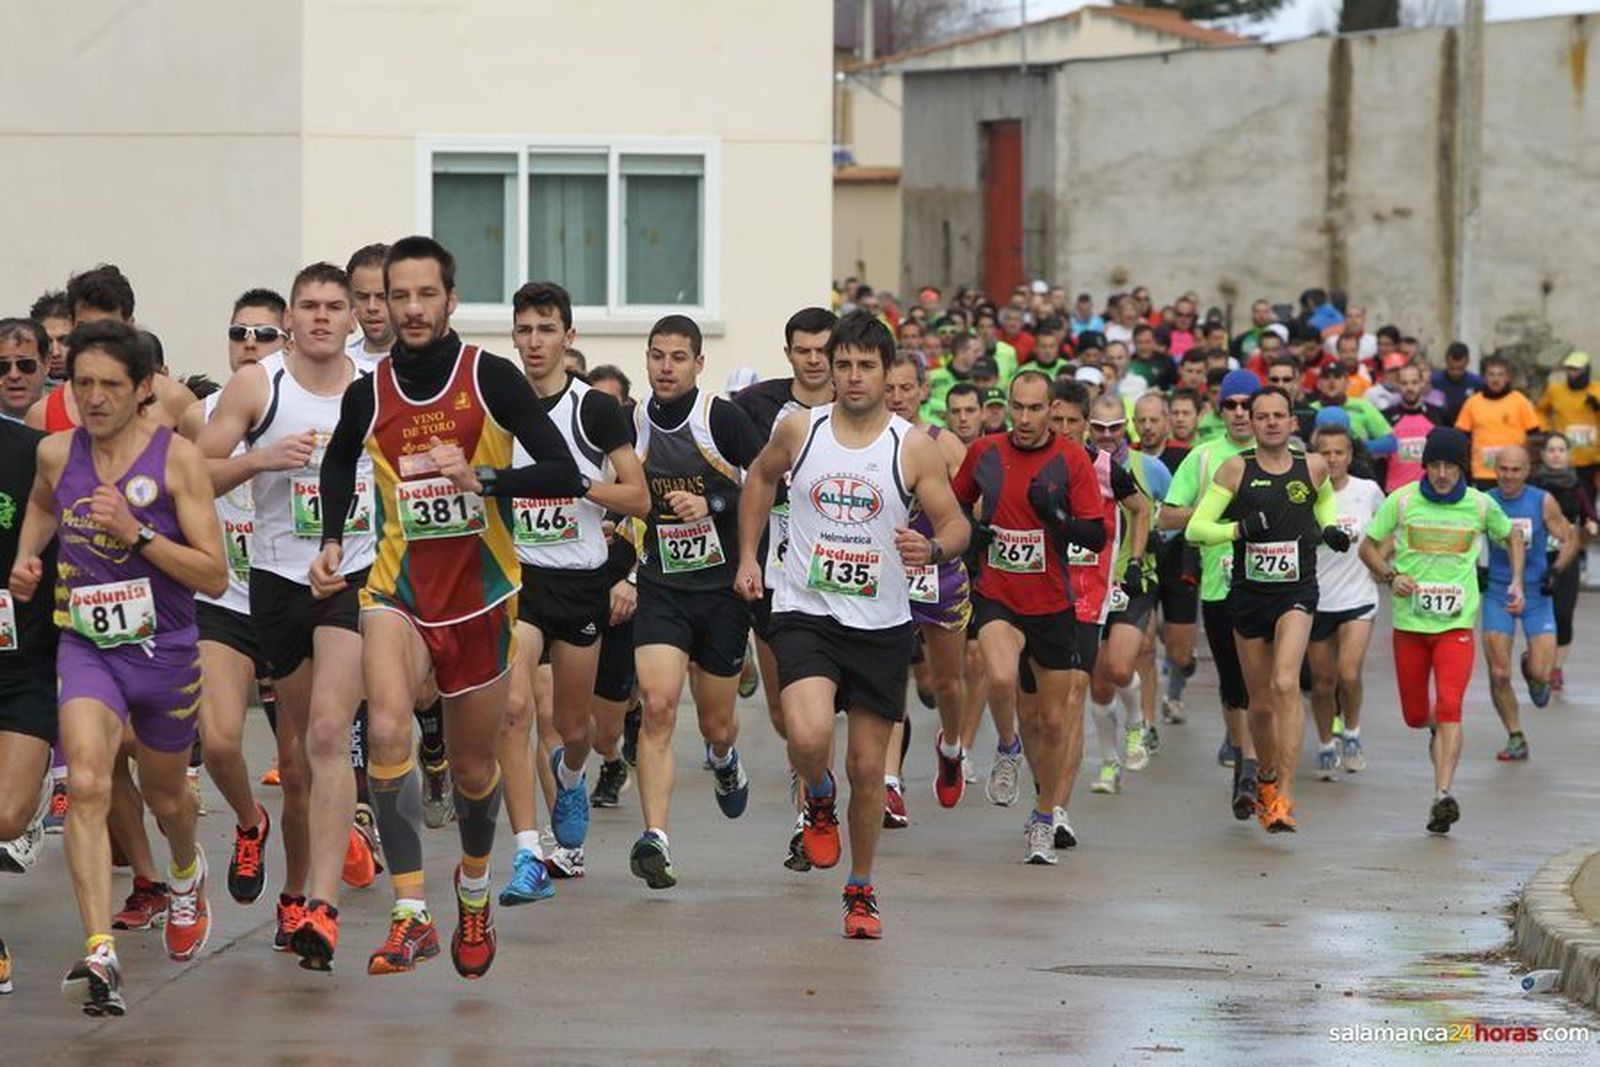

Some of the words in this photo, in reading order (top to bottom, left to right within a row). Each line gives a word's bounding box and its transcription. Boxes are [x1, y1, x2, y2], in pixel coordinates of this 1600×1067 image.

[412, 411, 445, 425] VINO
[402, 426, 420, 439] DE
[423, 420, 456, 435] TORO
[413, 495, 468, 526] 381
[521, 507, 568, 532] 146
[660, 523, 712, 539] bedunia
[668, 535, 707, 560] 327
[814, 543, 880, 564] bedunia
[998, 541, 1035, 562] 267
[823, 560, 870, 585] 135
[1254, 555, 1290, 572] 276
[906, 575, 928, 593] 74
[72, 583, 147, 607] bedunia
[1421, 594, 1457, 611] 317
[92, 603, 127, 634] 81
